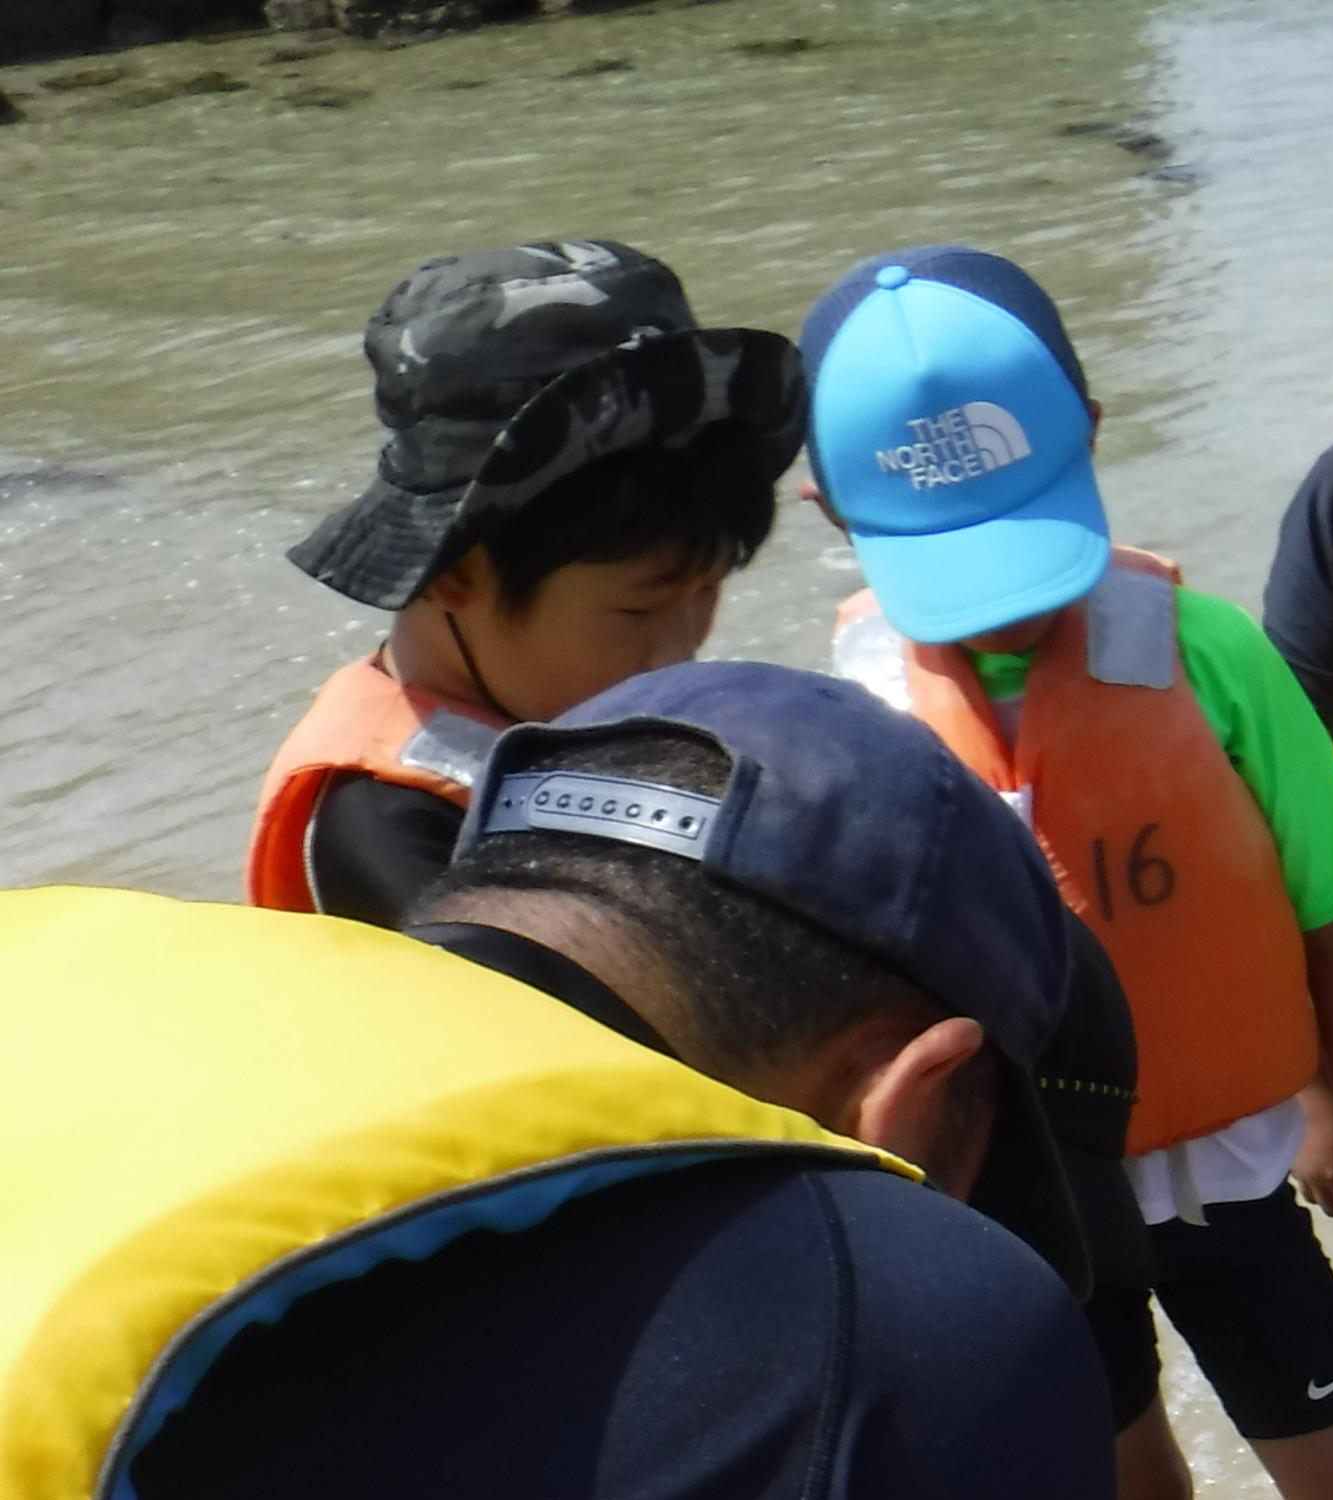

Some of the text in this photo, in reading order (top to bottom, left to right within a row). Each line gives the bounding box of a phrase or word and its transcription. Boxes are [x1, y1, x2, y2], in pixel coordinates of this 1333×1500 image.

[906, 407, 970, 443] THE
[875, 429, 979, 473] NORTH
[910, 453, 984, 490] FACE
[1093, 822, 1175, 922] 16
